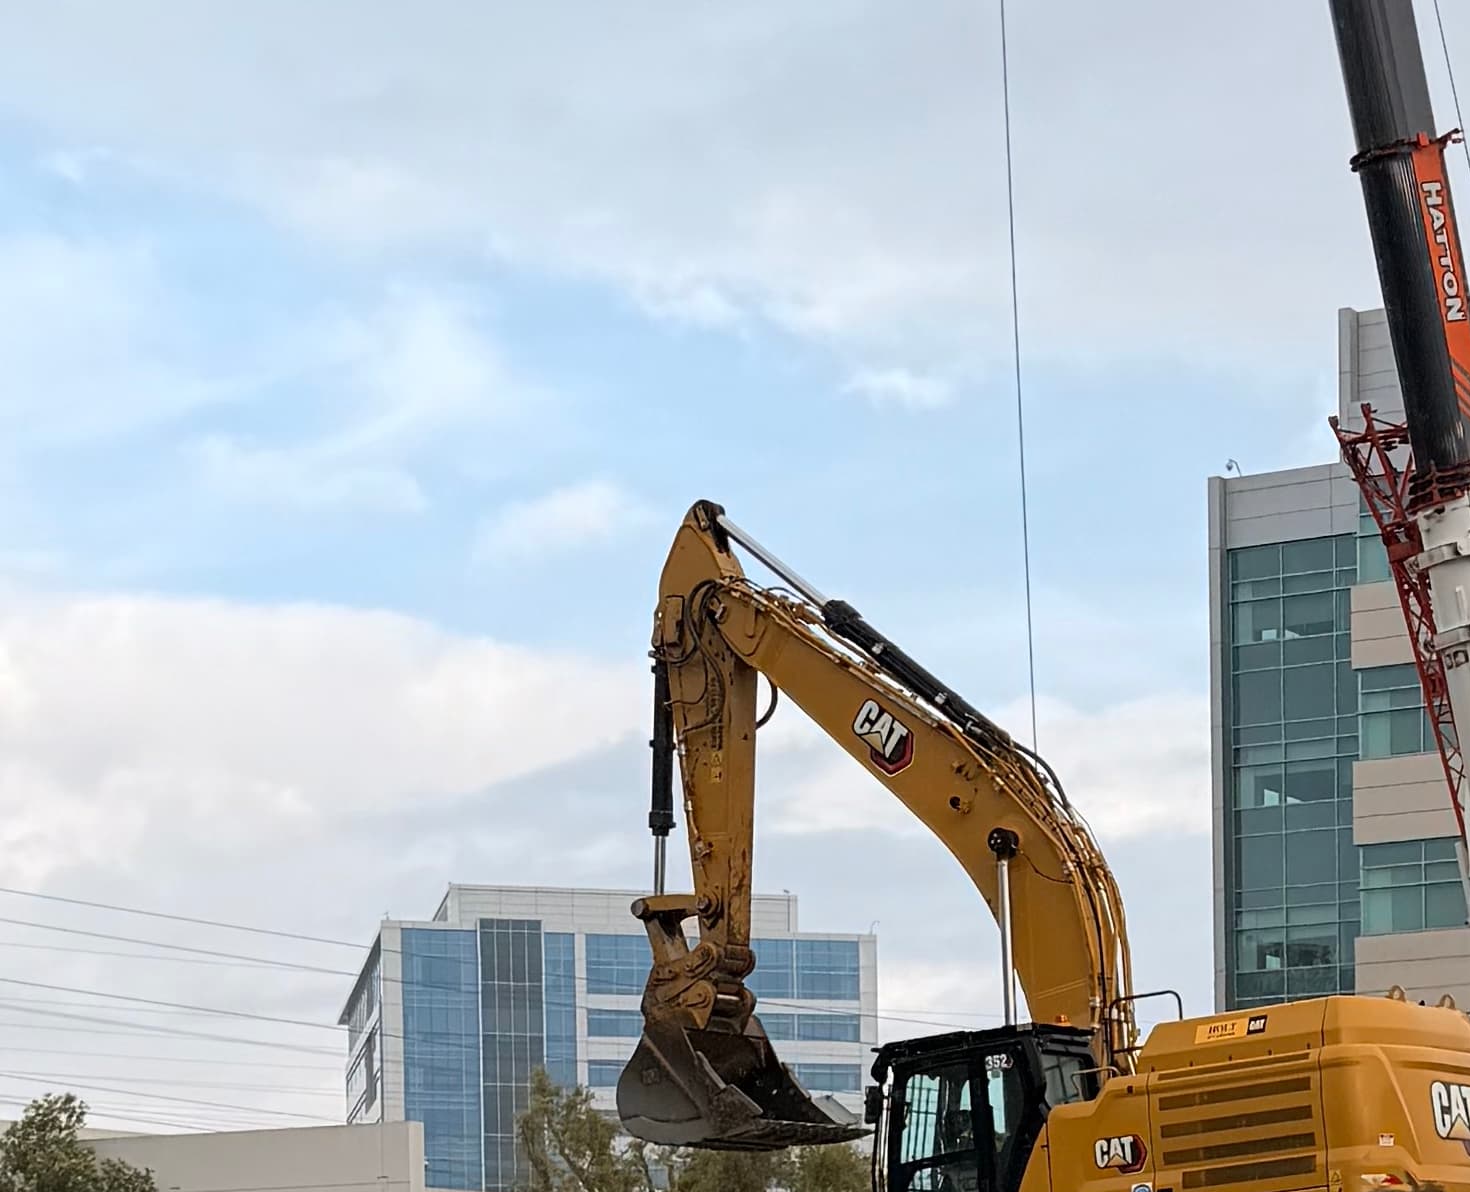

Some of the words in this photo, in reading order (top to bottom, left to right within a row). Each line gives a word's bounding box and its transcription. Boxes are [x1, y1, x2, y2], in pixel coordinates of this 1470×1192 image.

[1421, 180, 1467, 322] HATTON
[852, 699, 909, 759] CAT
[984, 1053, 1008, 1070] 352
[1094, 1135, 1134, 1169] CAT
